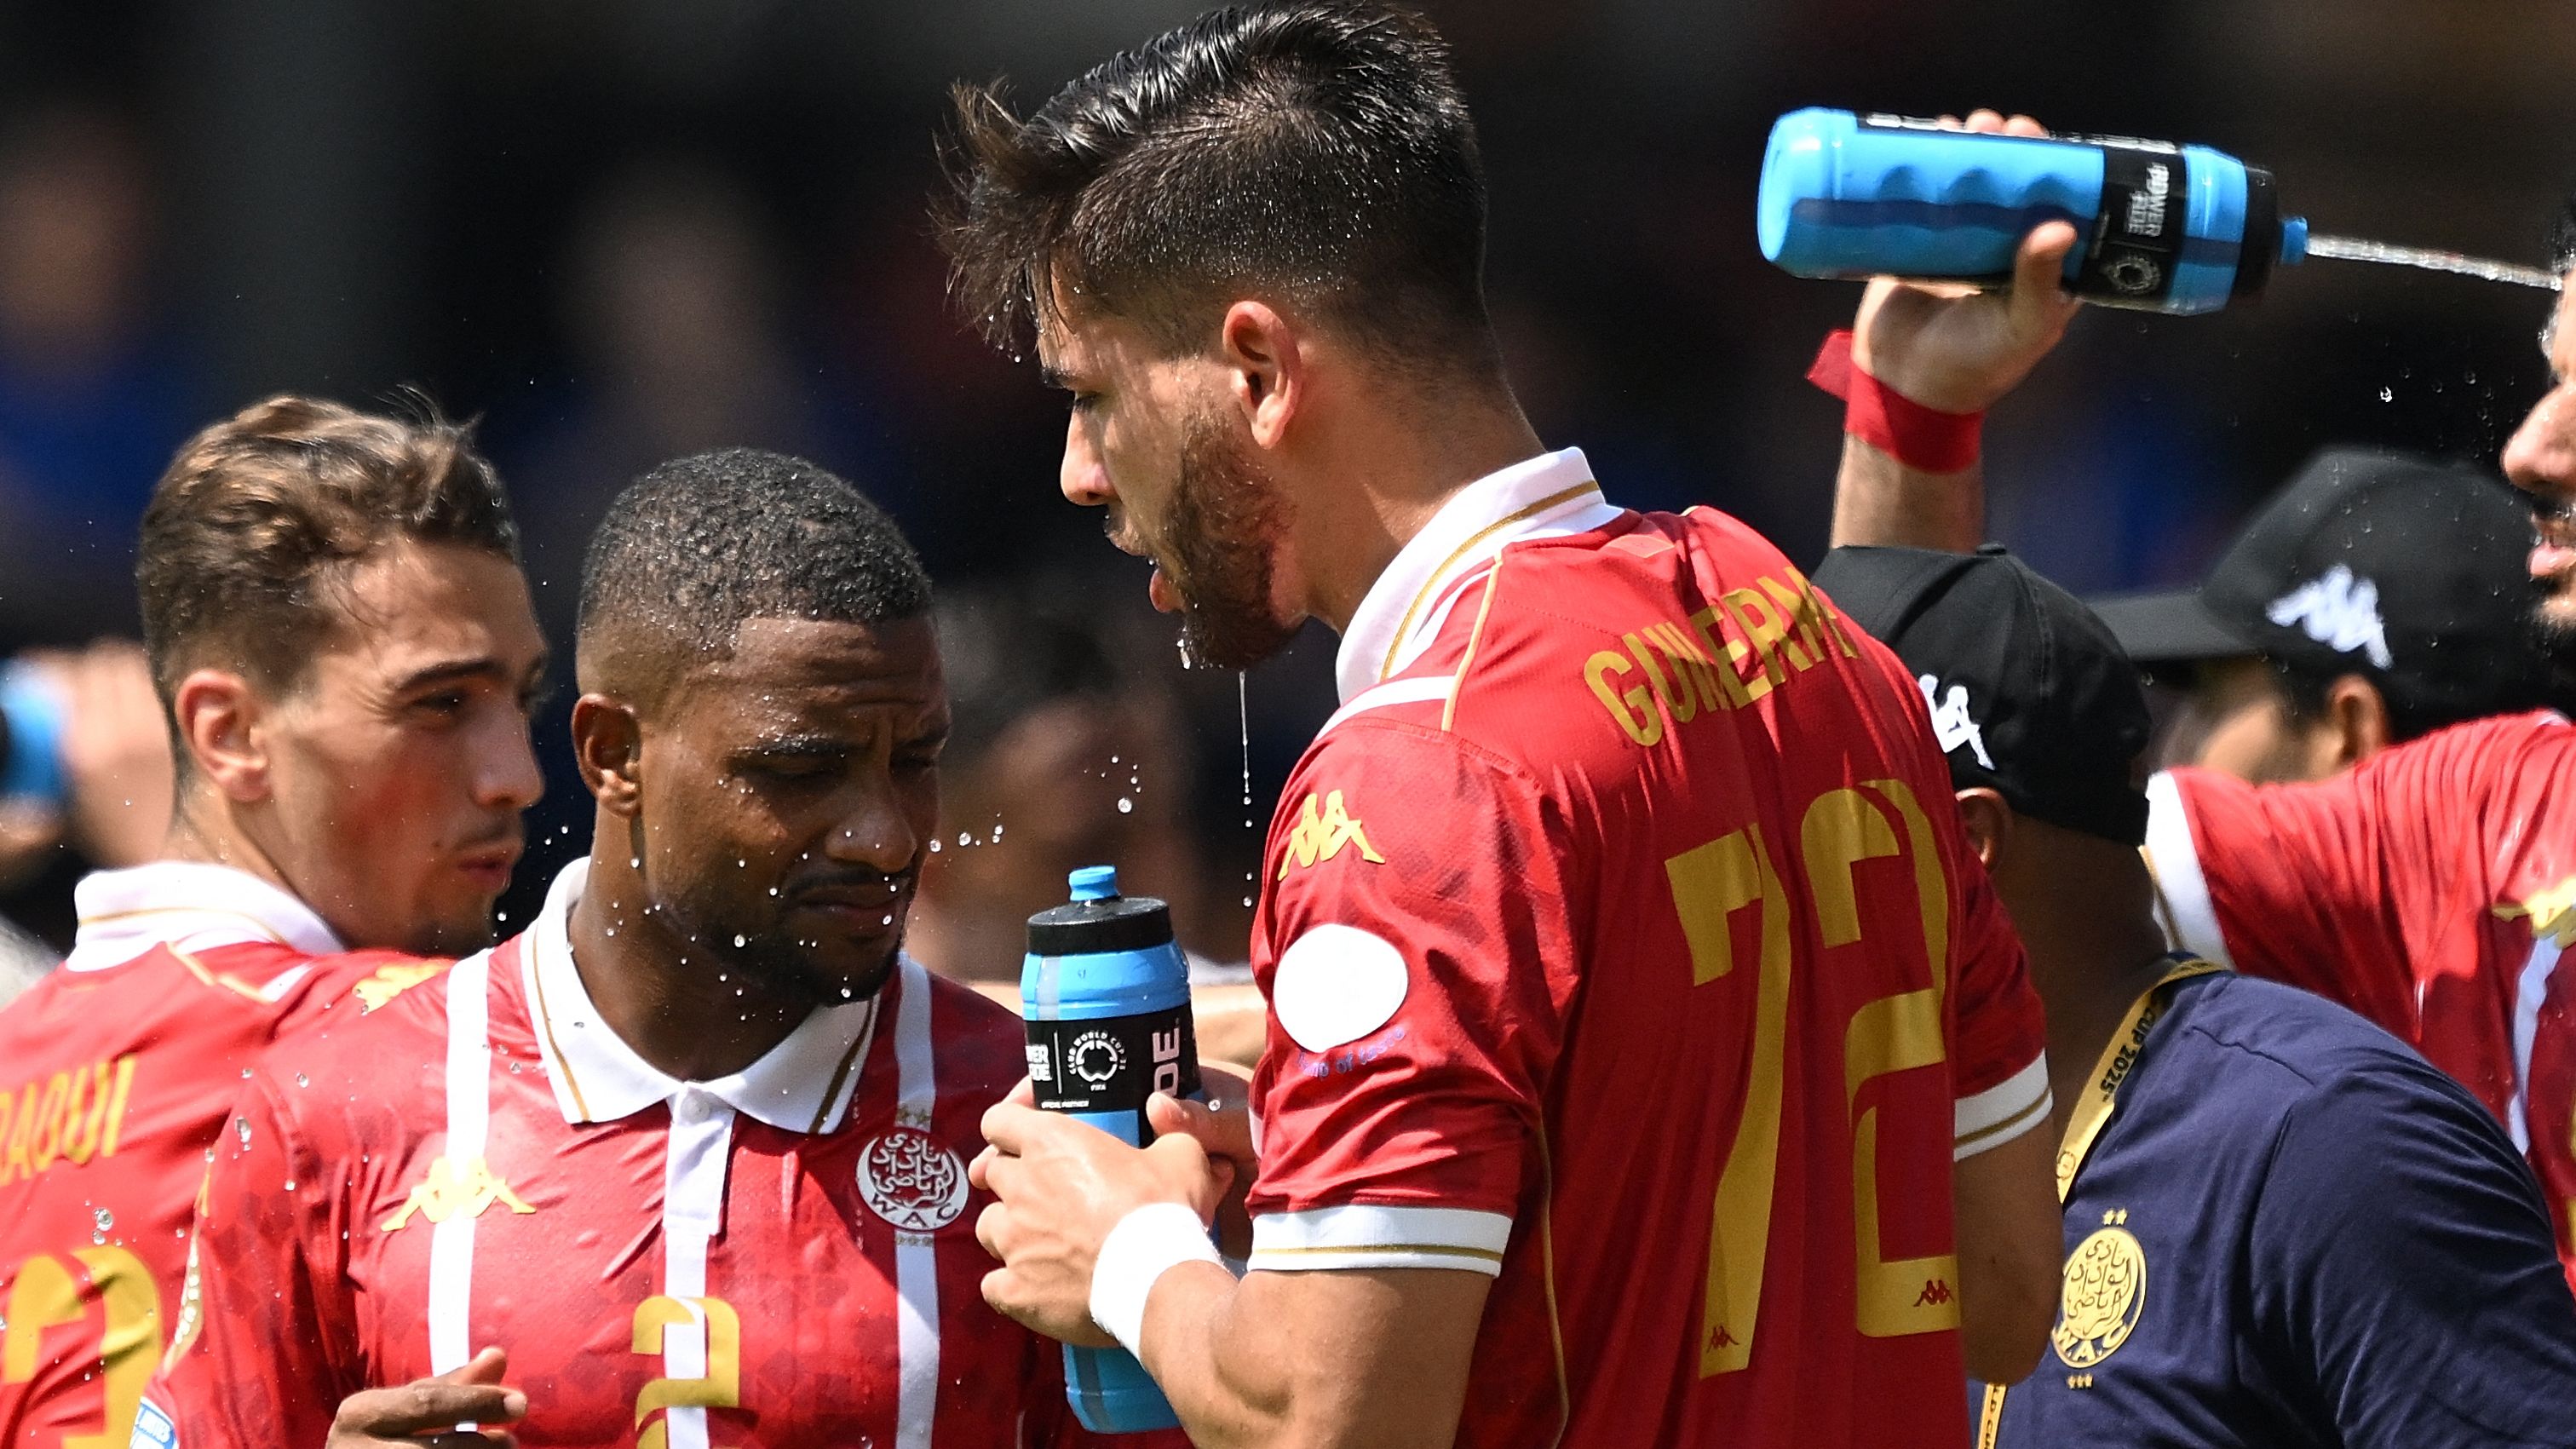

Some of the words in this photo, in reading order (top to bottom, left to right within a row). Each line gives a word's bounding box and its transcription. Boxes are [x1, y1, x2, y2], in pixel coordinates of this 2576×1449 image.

[2146, 162, 2169, 237] POWER
[1073, 1031, 1108, 1047] WORLD
[1110, 1037, 1125, 1055] CUP
[1665, 779, 1962, 1379] 72
[0, 1053, 135, 1186] AOUI
[631, 1295, 739, 1449] 2
